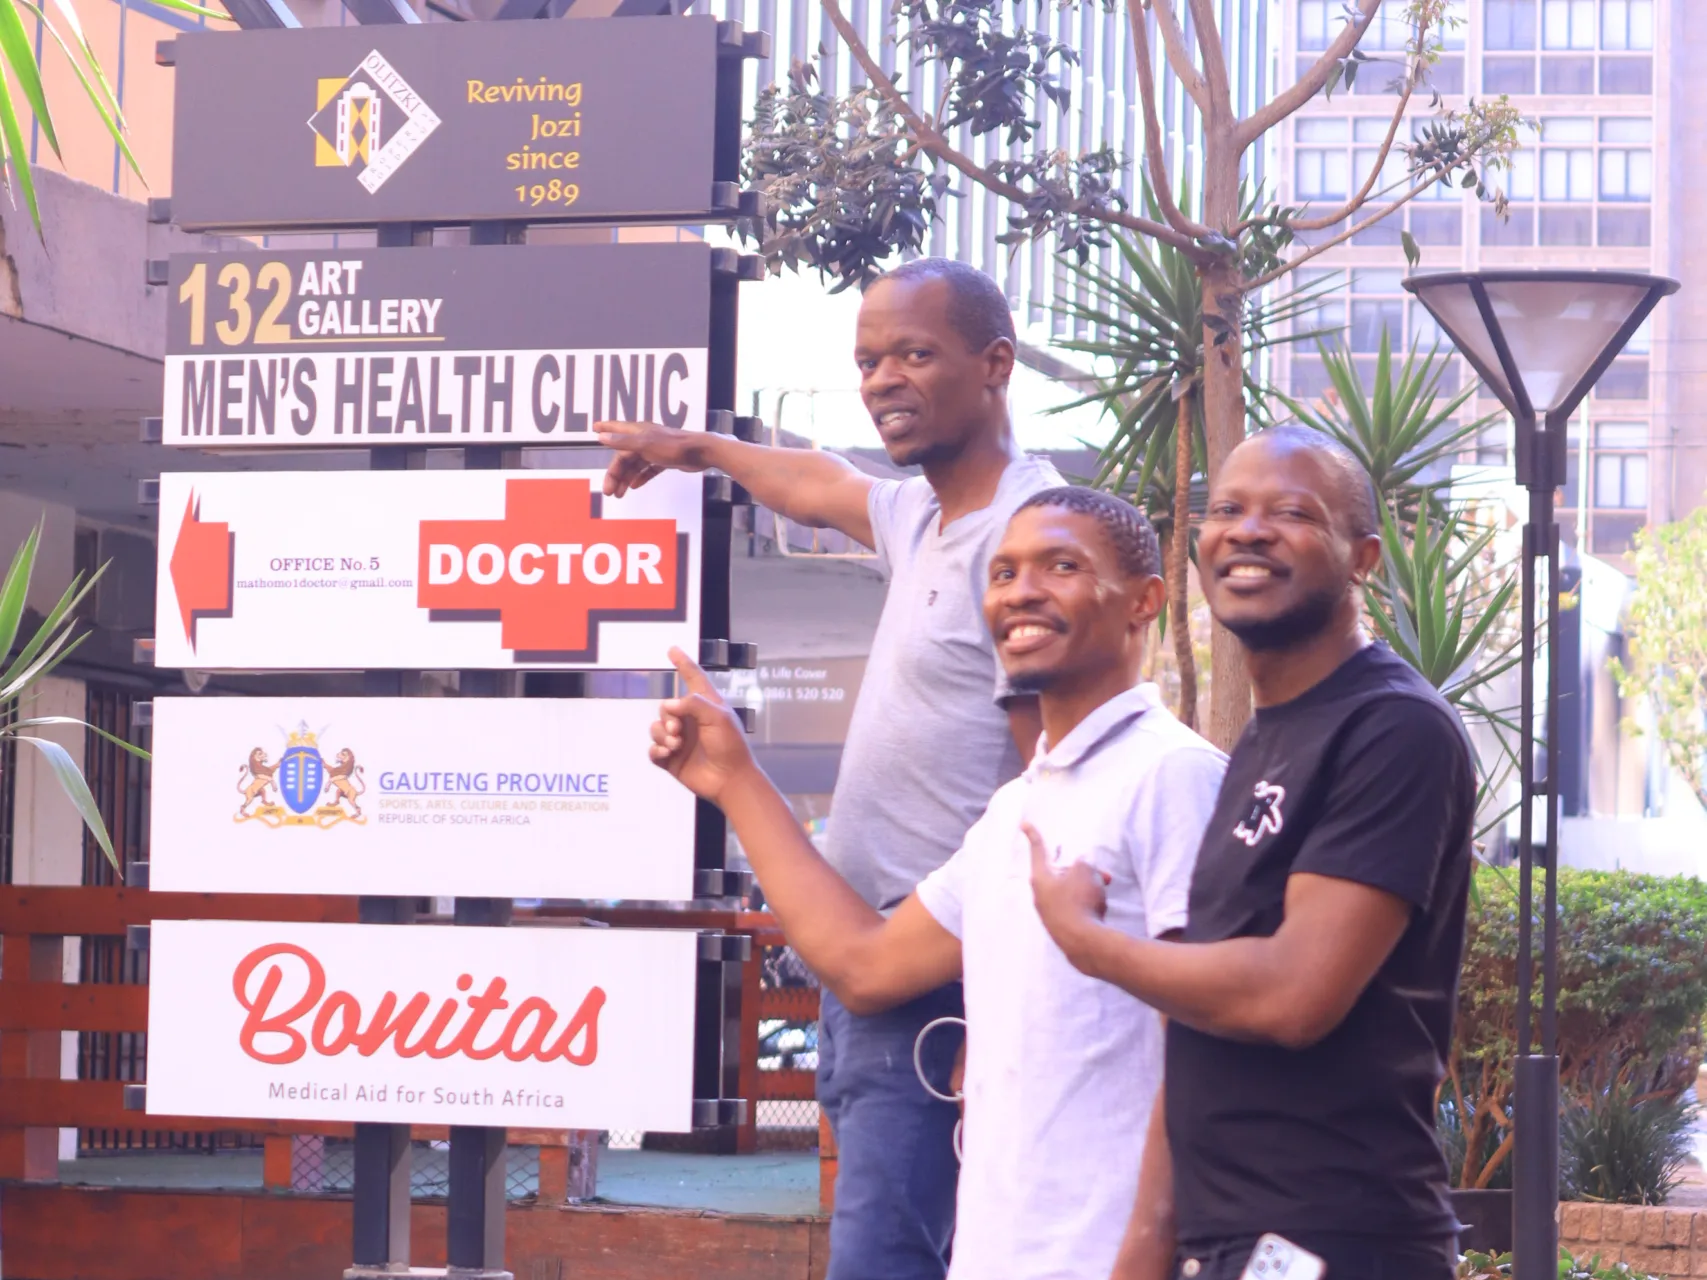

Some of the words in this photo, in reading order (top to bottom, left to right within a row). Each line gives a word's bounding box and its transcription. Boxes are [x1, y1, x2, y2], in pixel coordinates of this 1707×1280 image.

[367, 54, 422, 114] OLITZKI
[466, 77, 583, 106] Reviving
[530, 112, 581, 140] Jozi
[506, 145, 580, 170] since
[515, 179, 580, 206] 1989
[299, 260, 362, 296] ART
[179, 261, 292, 346] 132
[298, 298, 443, 336] GALLERY
[334, 354, 515, 436] HEALTH
[531, 352, 689, 434] CLINIC
[269, 557, 335, 571] OFFICE
[339, 557, 366, 571] No.
[368, 556, 381, 571] 5
[428, 543, 664, 585] DOCTOR
[794, 667, 827, 679] Cover
[796, 687, 819, 700] 520
[821, 687, 844, 700] 520
[379, 771, 489, 792] GAUTENG
[496, 773, 609, 793] PROVINCE
[378, 799, 422, 811] SPORTS,
[426, 799, 457, 811] ARTS,
[460, 800, 509, 811] CULTURE
[512, 801, 537, 812] AND
[540, 801, 609, 813] RECREATION
[378, 814, 430, 825] REPUBLIC
[432, 814, 447, 825] OF
[450, 814, 488, 826] SOUTH
[491, 815, 531, 826] AFRICA
[232, 942, 606, 1066] Bonitas
[268, 1082, 347, 1101] Medical
[355, 1084, 388, 1102] Aid
[396, 1085, 425, 1103] for
[433, 1087, 493, 1106] South
[502, 1089, 565, 1108] Africa
